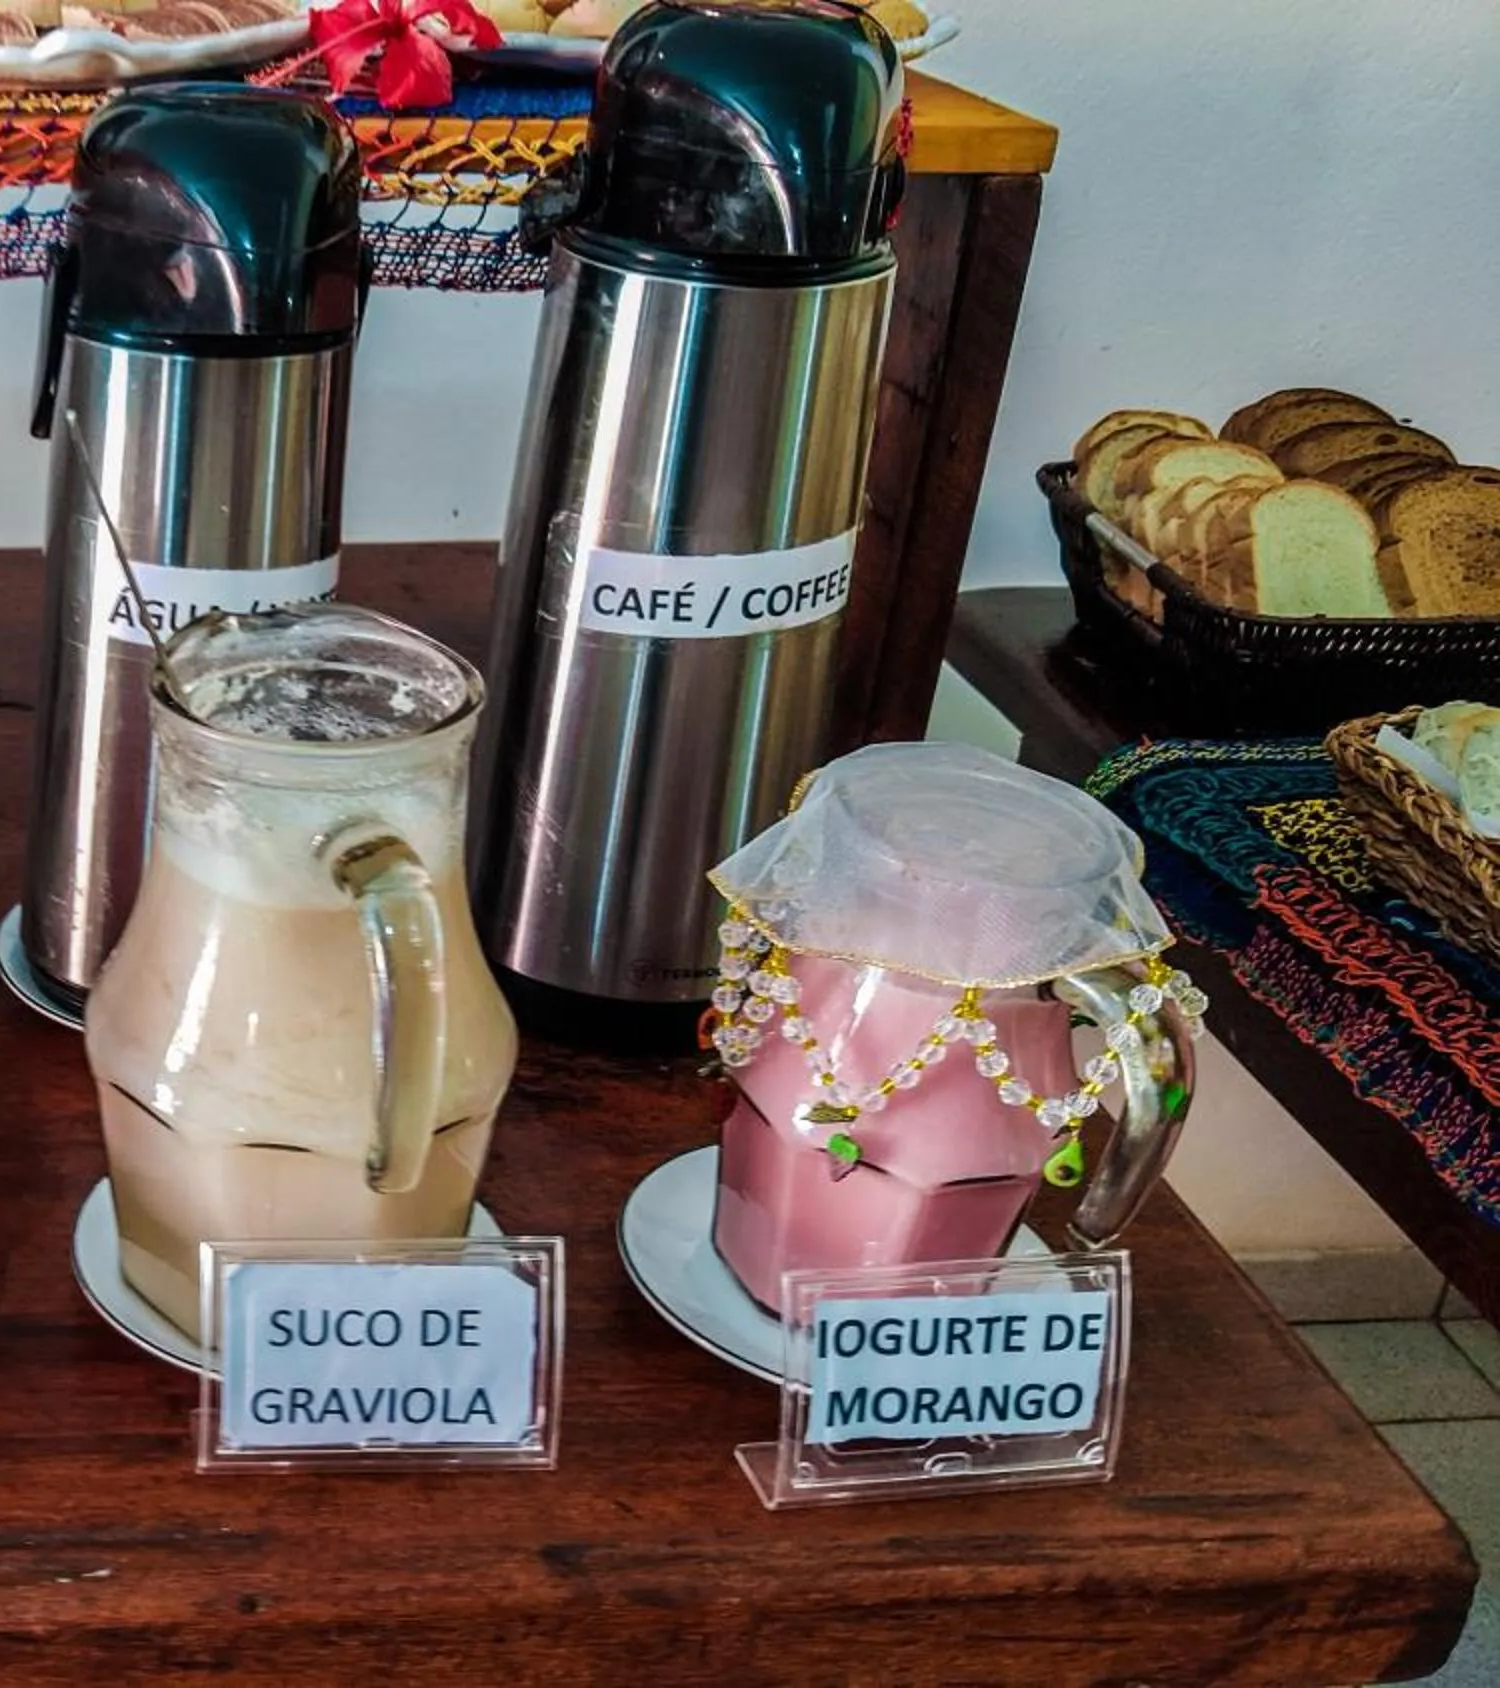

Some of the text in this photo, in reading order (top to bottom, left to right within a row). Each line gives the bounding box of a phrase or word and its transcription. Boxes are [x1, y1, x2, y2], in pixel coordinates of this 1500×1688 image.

[591, 581, 696, 622] CAFÉ
[740, 563, 849, 620] COFFEE
[267, 1308, 482, 1348] SUCO DE
[817, 1313, 1103, 1359] IOGURTE DE
[251, 1387, 496, 1425] GRAVIOLA
[825, 1382, 1084, 1427] MORANGO
